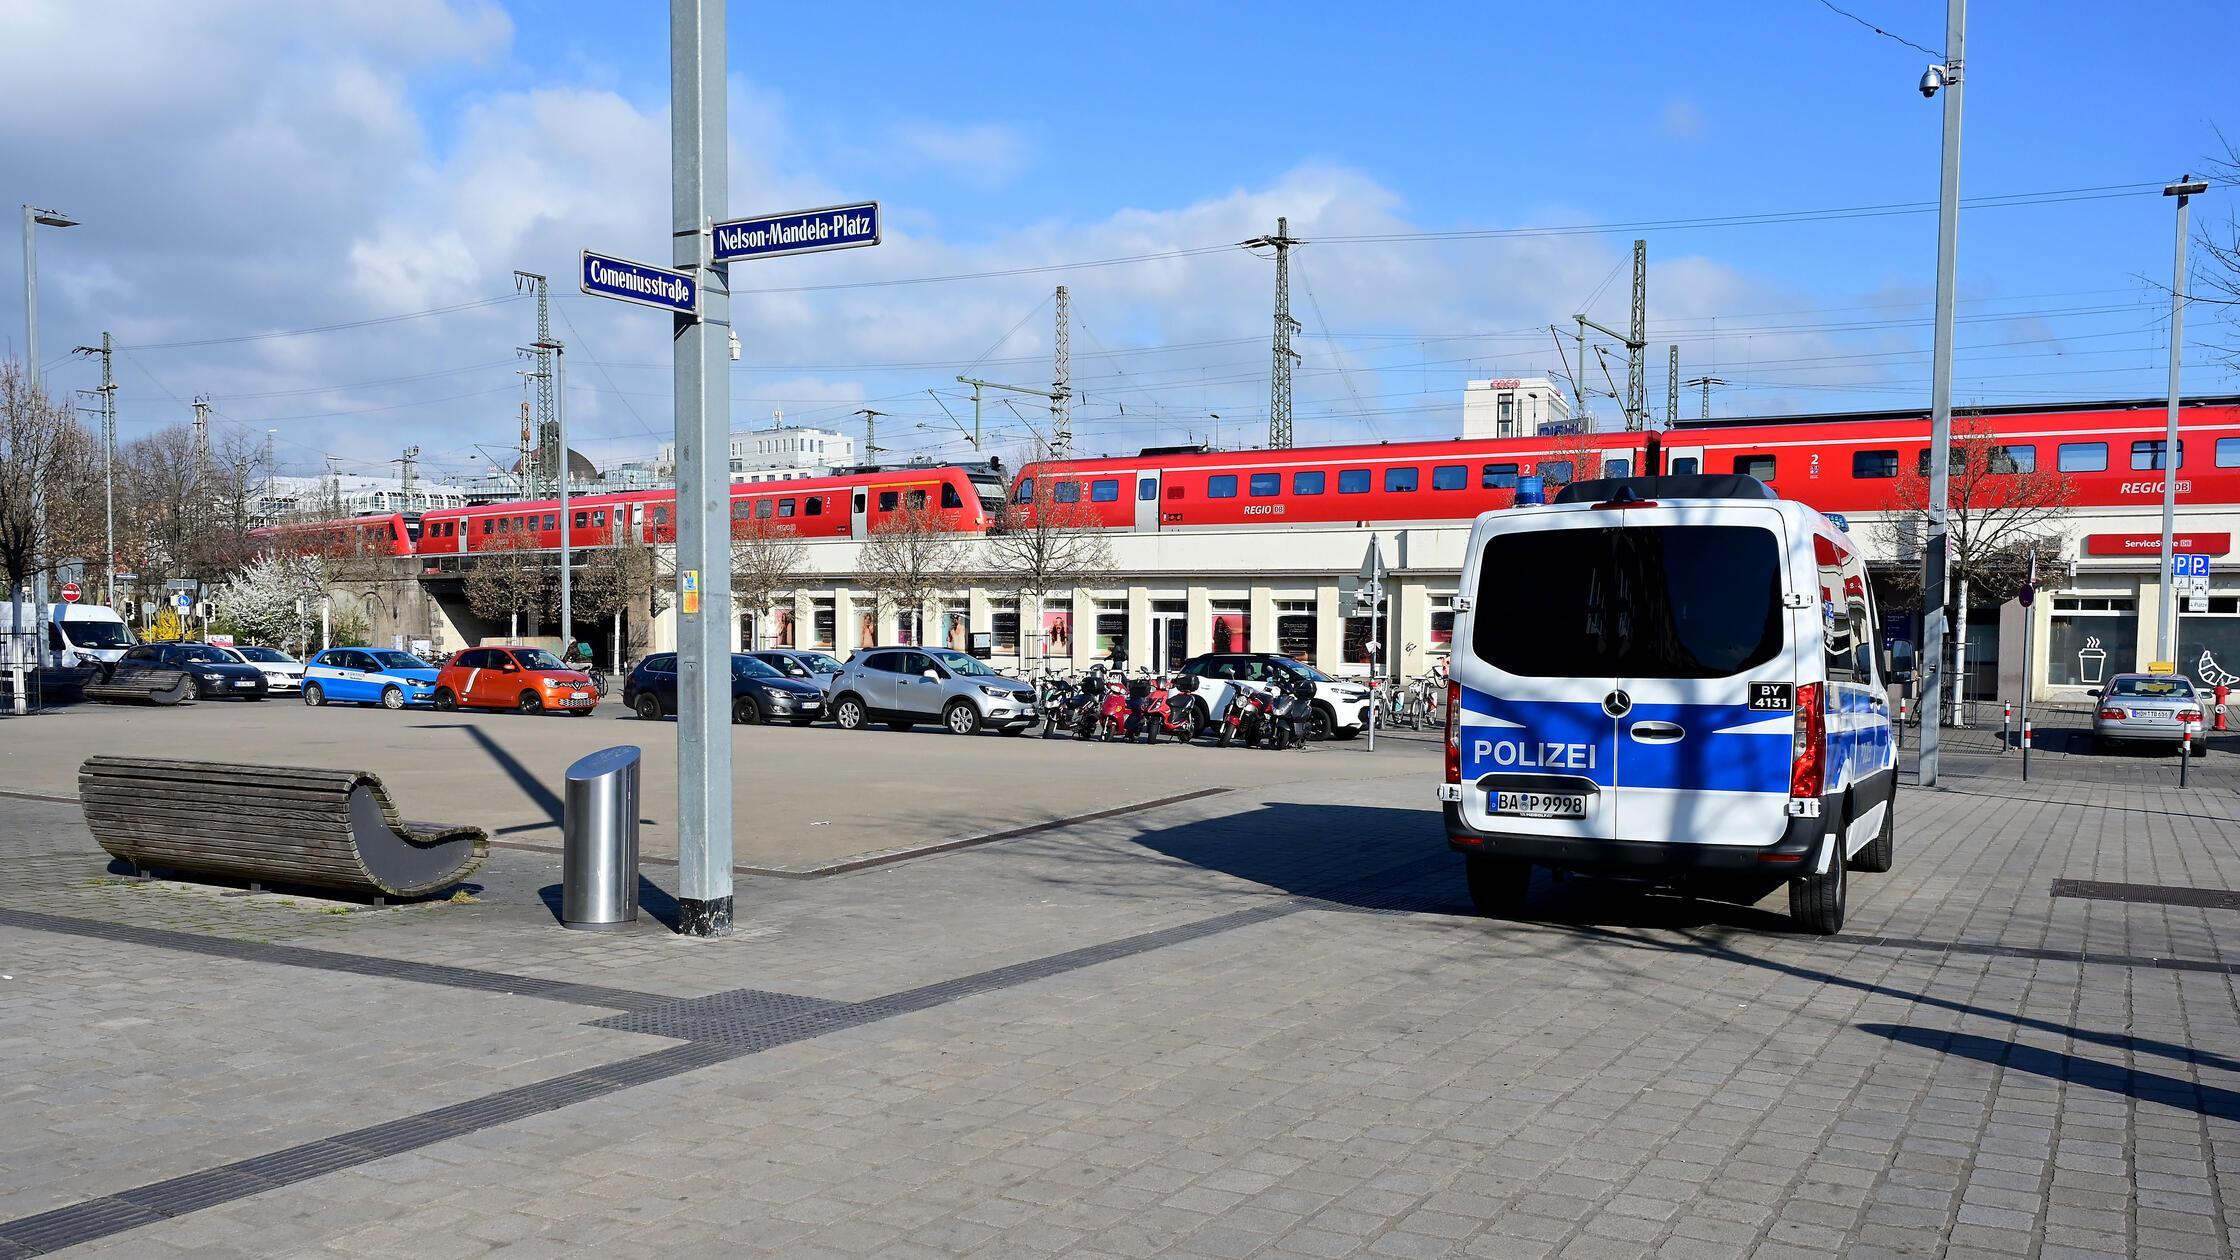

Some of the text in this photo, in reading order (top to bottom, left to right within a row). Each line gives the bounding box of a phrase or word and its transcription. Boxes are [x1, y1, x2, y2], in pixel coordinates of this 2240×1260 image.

[719, 214, 870, 251] Nelson-Mandela-Platz
[591, 260, 689, 302] Comeniusstraße
[1811, 453, 1819, 464] 2
[1524, 464, 1530, 474] 2
[1083, 482, 1089, 491] 2
[1244, 505, 1271, 514] REGIO
[2177, 557, 2186, 573] P
[2193, 557, 2204, 574] P
[1761, 685, 1780, 695] BY
[1755, 698, 1787, 707] 4131
[1474, 740, 1596, 769] POLIZEI
[1499, 794, 1518, 810] BA
[1530, 796, 1539, 811] P
[1543, 797, 1582, 813] 9998
